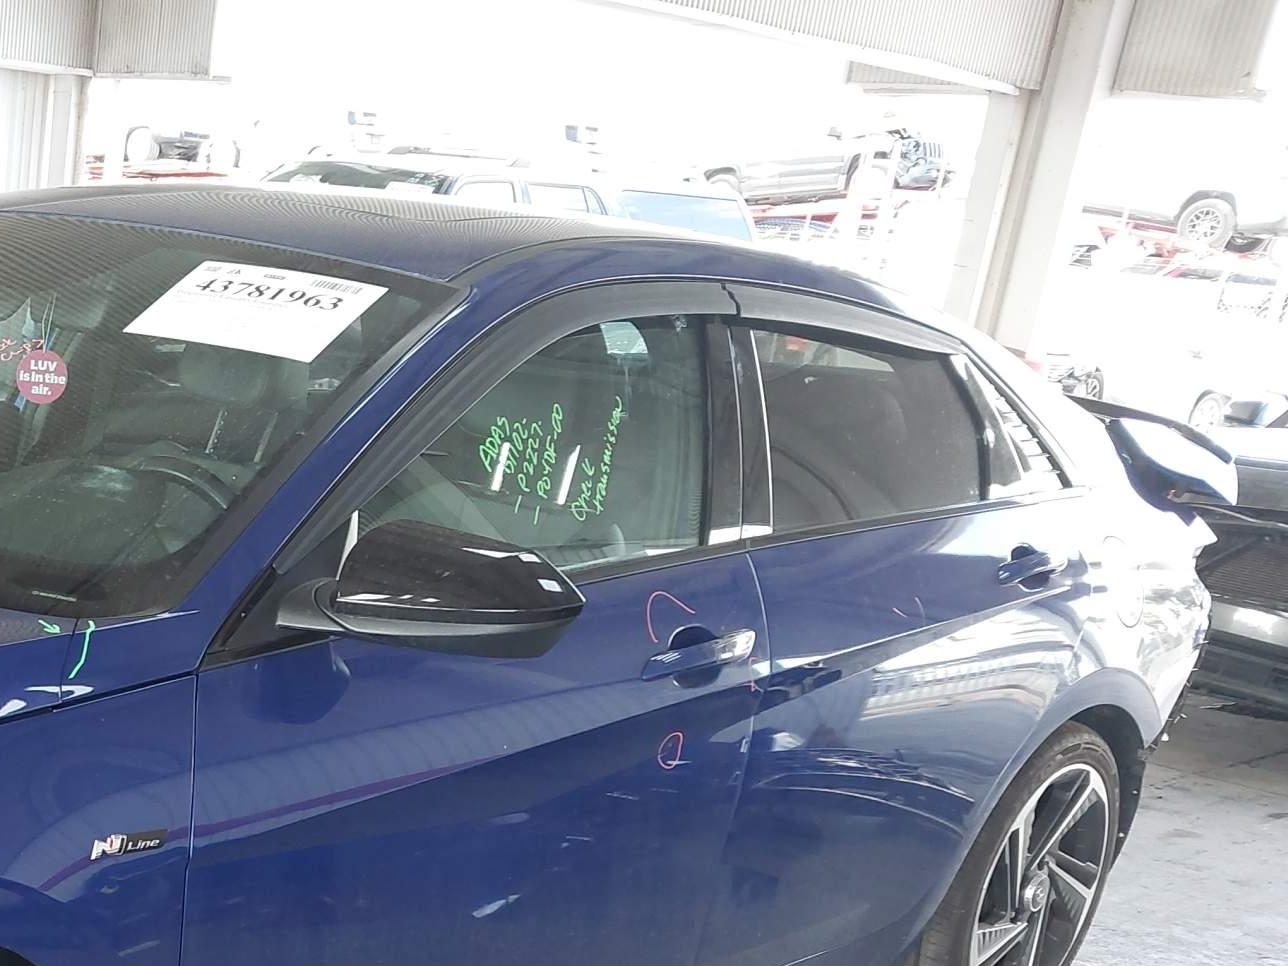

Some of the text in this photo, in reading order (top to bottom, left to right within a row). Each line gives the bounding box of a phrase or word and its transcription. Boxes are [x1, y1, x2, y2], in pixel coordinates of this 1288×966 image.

[195, 278, 344, 311] 43781963
[30, 359, 58, 371] LUV
[31, 384, 52, 395] air.
[479, 416, 510, 473] ADAS
[126, 838, 161, 852] Line
